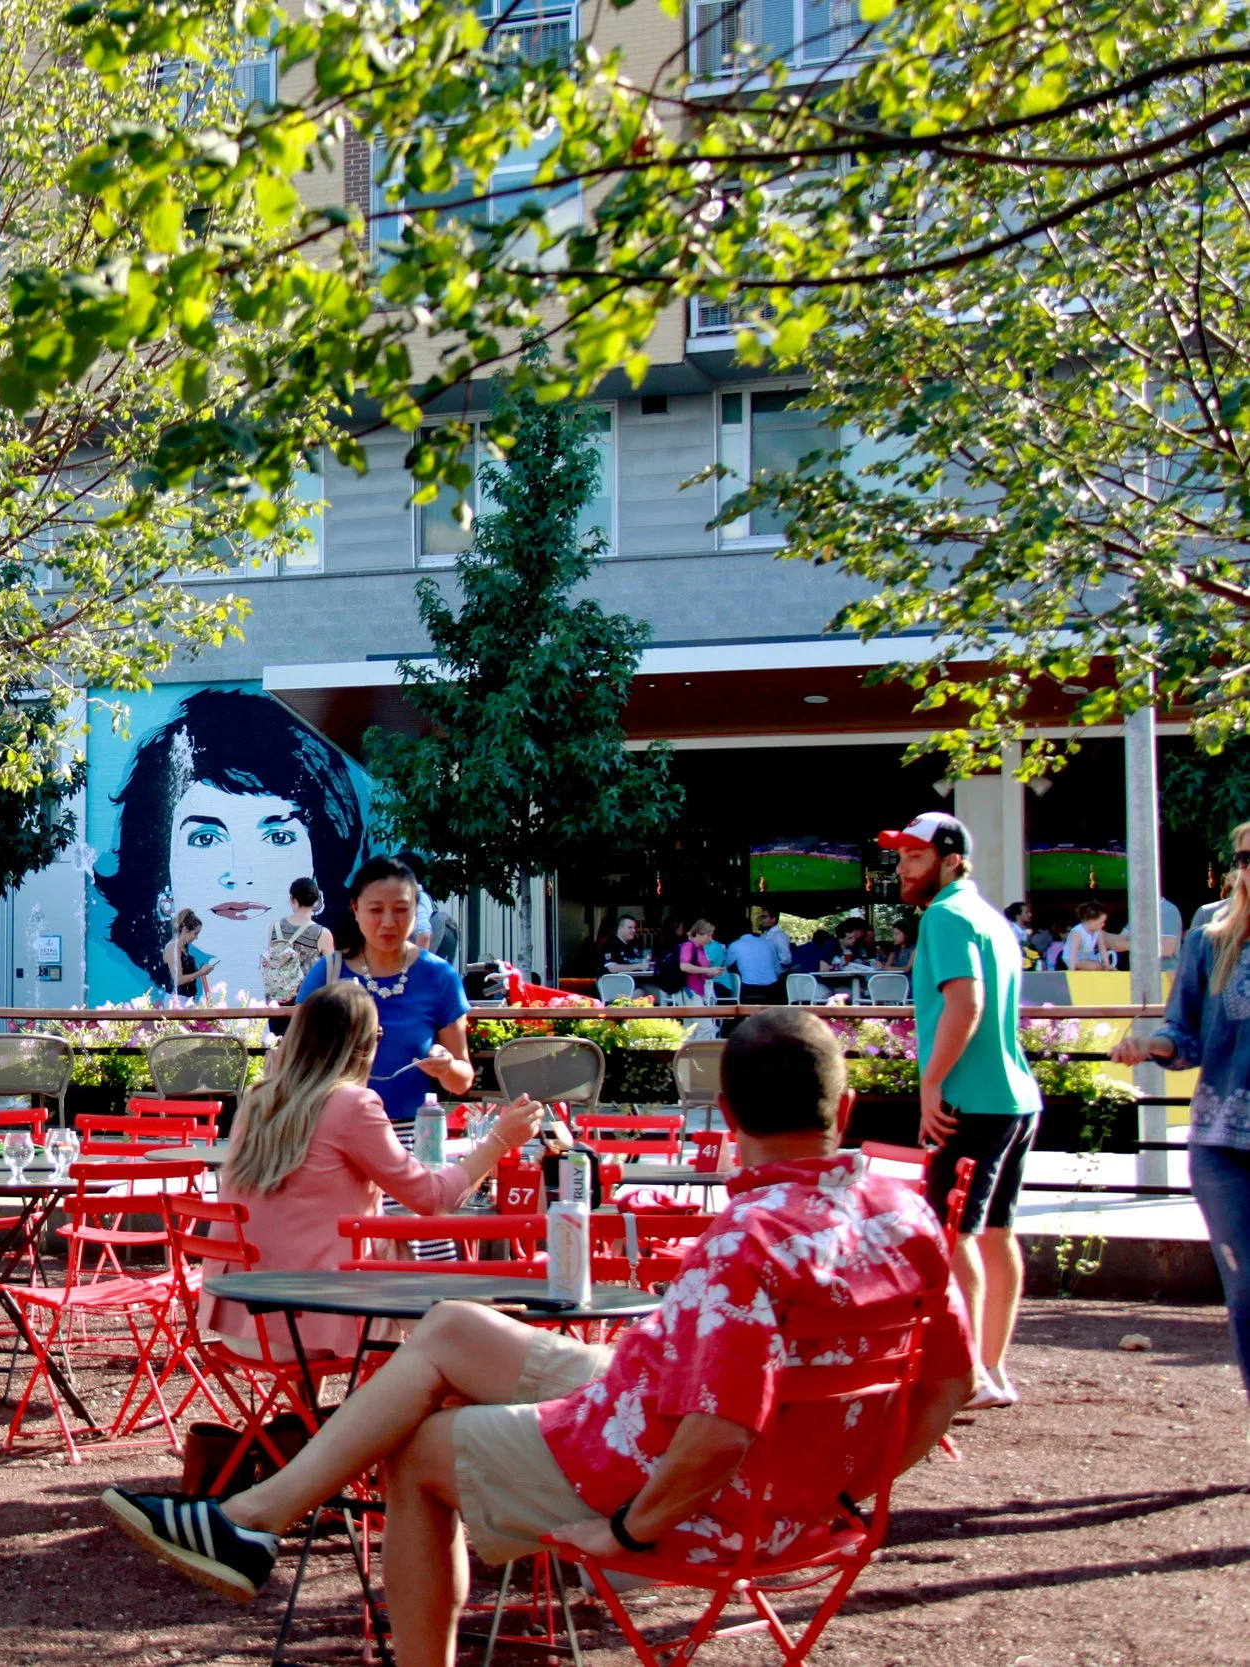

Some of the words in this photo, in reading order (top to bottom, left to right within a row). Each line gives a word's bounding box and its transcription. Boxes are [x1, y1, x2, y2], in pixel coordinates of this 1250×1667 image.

[702, 1144, 717, 1158] 41
[574, 1168, 584, 1202] RULY
[507, 1187, 535, 1205] 57
